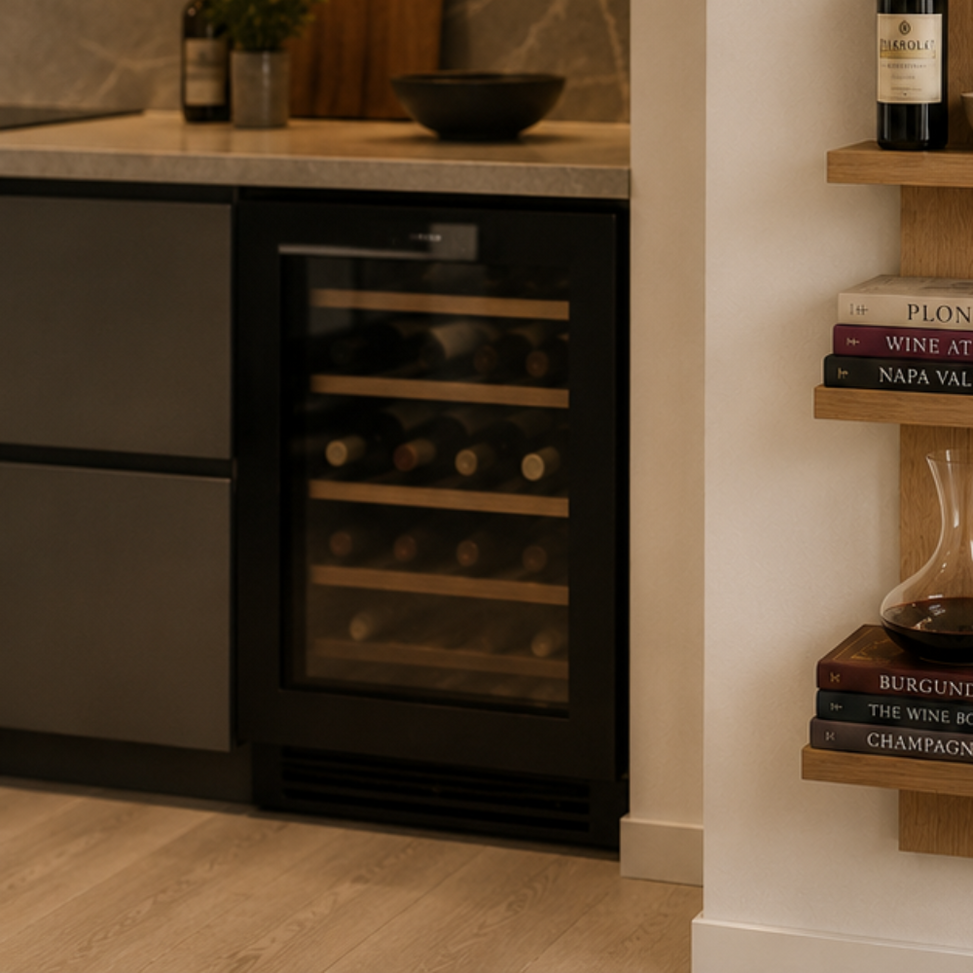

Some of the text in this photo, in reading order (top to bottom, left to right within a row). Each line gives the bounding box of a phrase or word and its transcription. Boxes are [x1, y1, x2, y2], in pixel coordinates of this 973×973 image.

[886, 335, 940, 354] WINE
[879, 367, 929, 385] NAPA
[868, 703, 901, 719] THE
[907, 707, 950, 723] WINE
